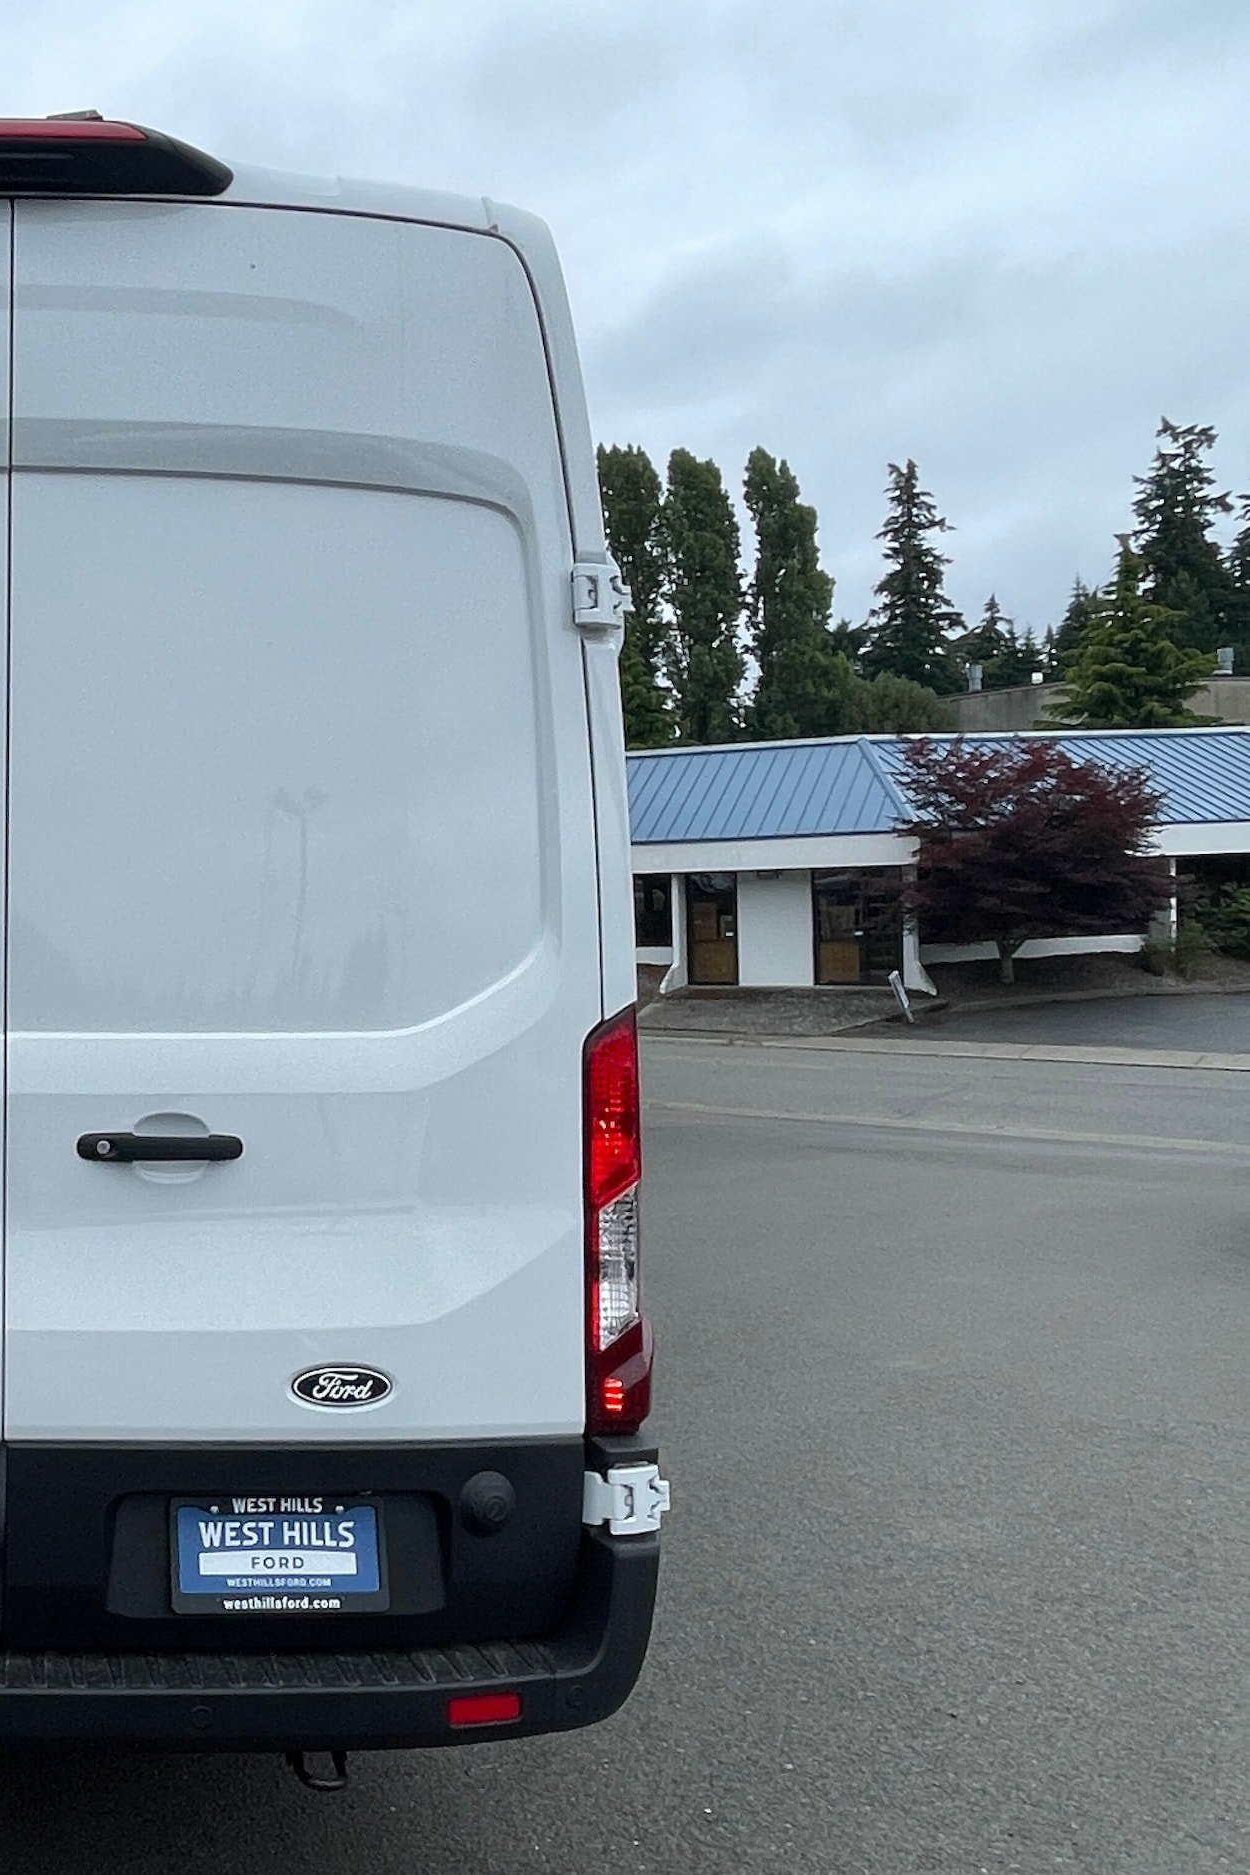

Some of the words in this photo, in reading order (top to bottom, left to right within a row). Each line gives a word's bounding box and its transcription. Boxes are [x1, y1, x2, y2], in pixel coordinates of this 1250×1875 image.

[312, 1372, 373, 1399] Ford
[232, 1498, 276, 1514] WEST
[280, 1498, 323, 1513] HILLS
[199, 1521, 275, 1548] WEST
[282, 1521, 356, 1548] HILLS
[251, 1556, 305, 1569] FORD
[226, 1578, 332, 1587] WESTHILLSFORD.COM
[223, 1596, 341, 1610] westhillsford.com
